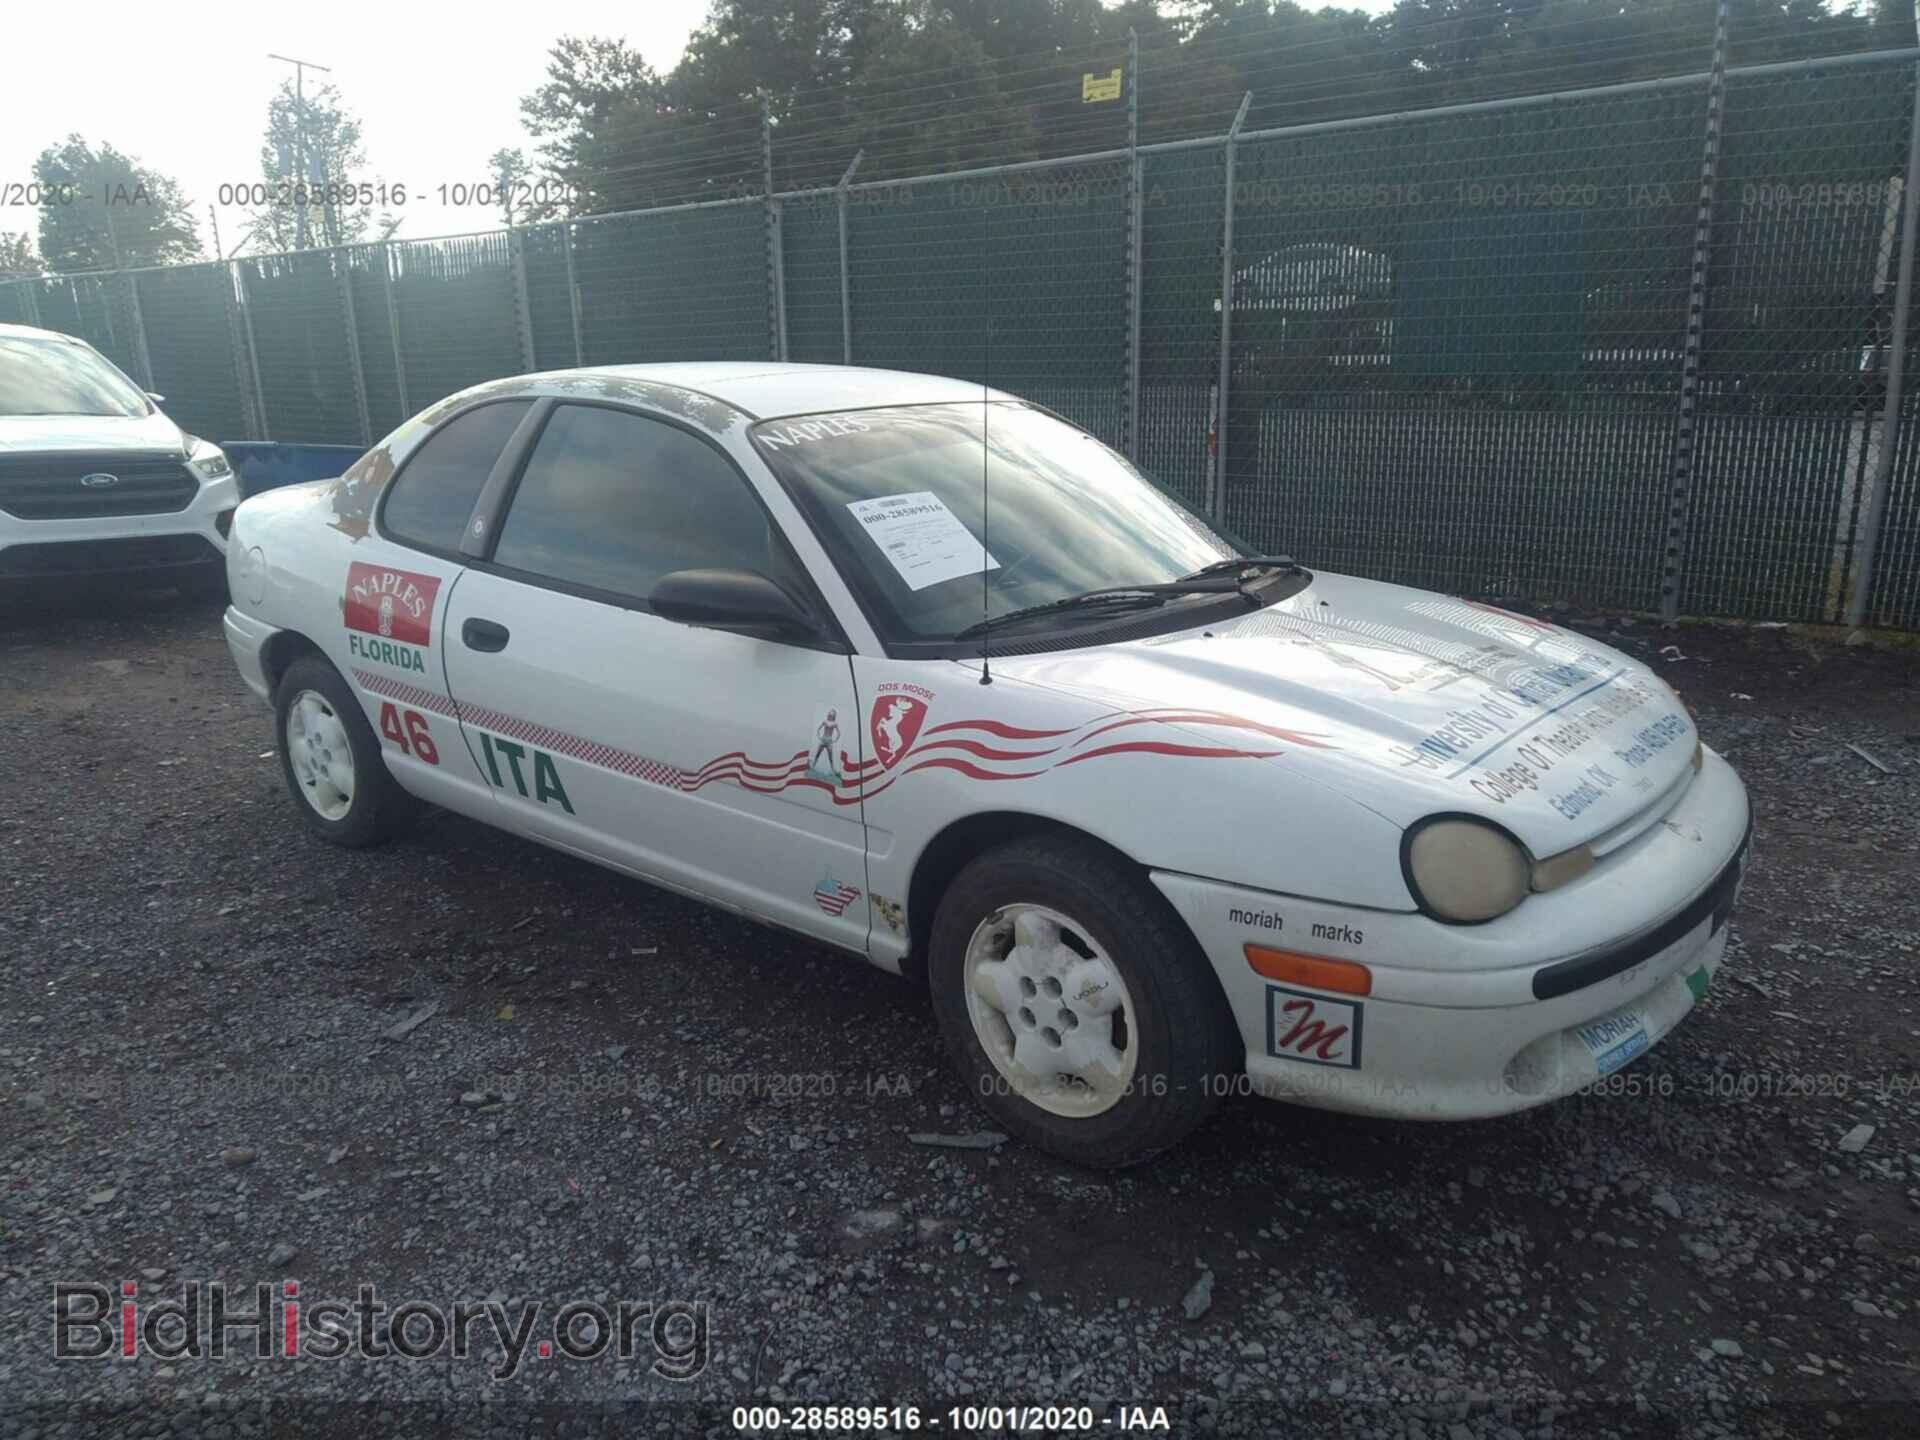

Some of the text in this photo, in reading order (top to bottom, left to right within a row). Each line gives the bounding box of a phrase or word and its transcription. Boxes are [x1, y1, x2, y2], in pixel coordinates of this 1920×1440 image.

[757, 416, 870, 450] NAPLES
[863, 503, 943, 524] 000-28589516
[352, 572, 426, 618] NAPLES
[349, 634, 425, 673] FLORIDA
[380, 701, 440, 765] 46
[1389, 710, 1508, 770] University
[479, 731, 577, 816] ITA
[1469, 761, 1539, 804] College
[1229, 908, 1364, 945] moriah marks
